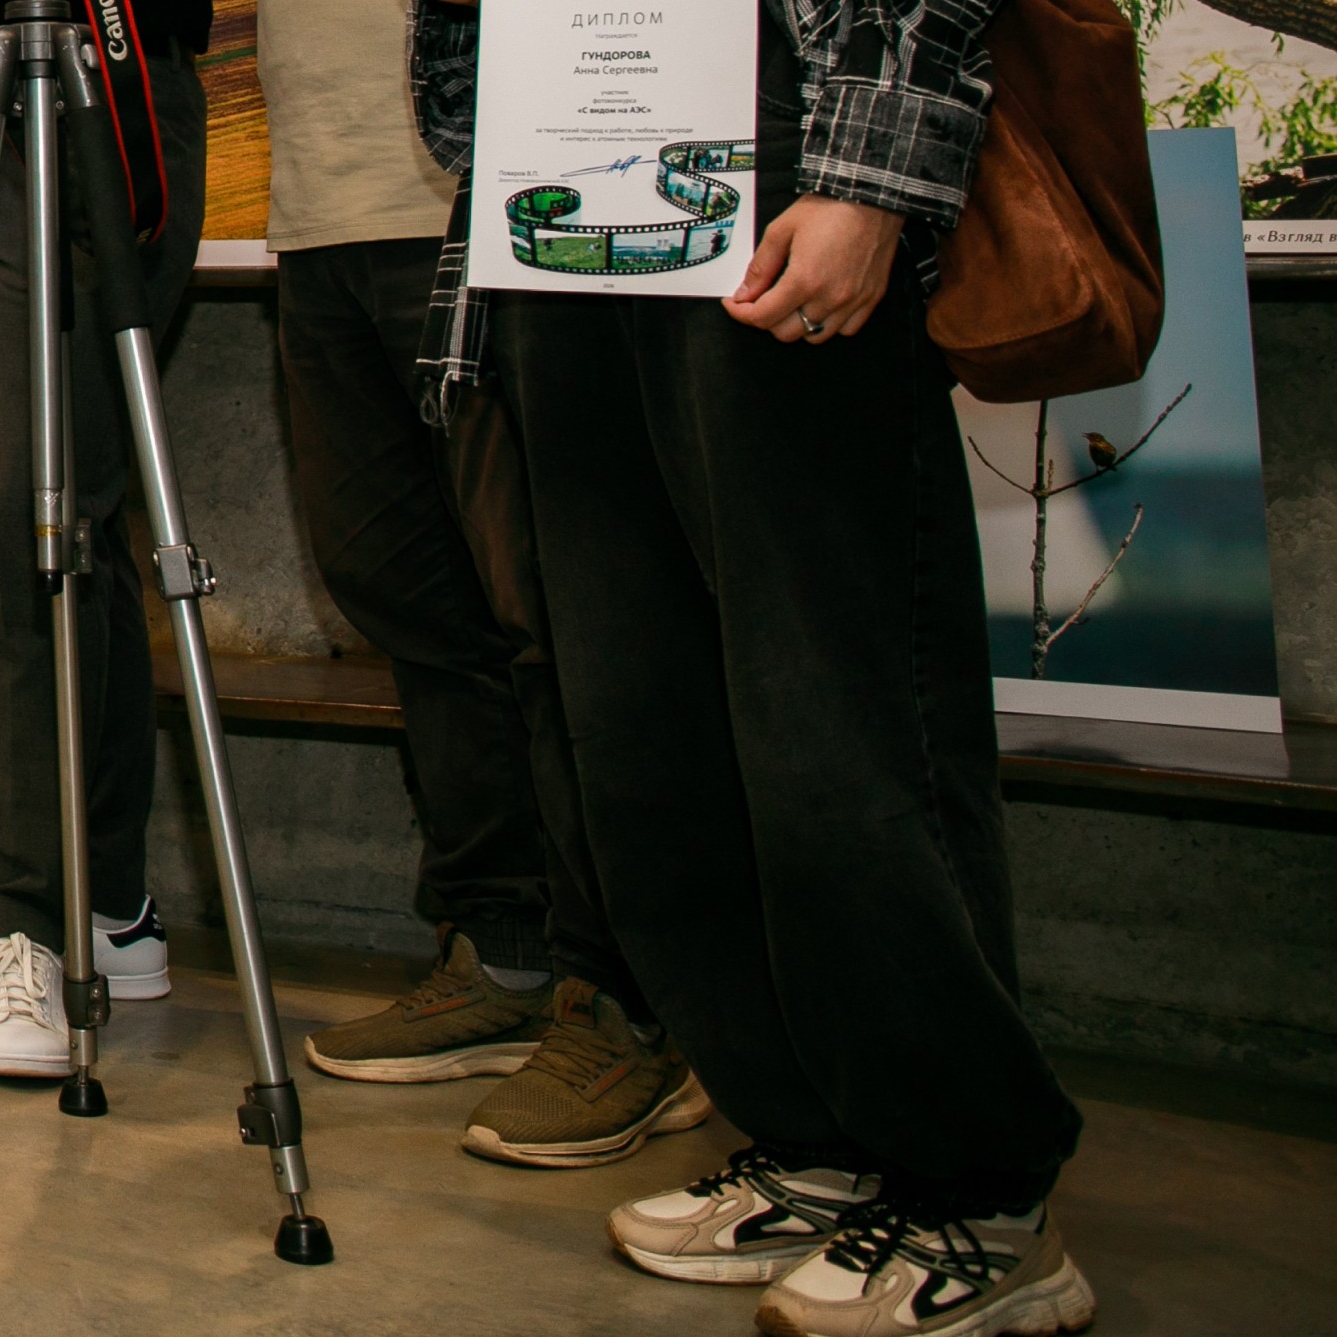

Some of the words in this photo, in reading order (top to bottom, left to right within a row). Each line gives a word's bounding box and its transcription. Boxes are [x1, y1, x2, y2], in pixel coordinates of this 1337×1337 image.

[571, 11, 663, 29] ДИПЛОМ
[581, 50, 652, 62] ГУНДОРОВА
[573, 65, 600, 75] Анна
[602, 65, 659, 77] Сергеевна
[629, 106, 653, 114] АЭС»
[1256, 230, 1325, 244] «Взгляд
